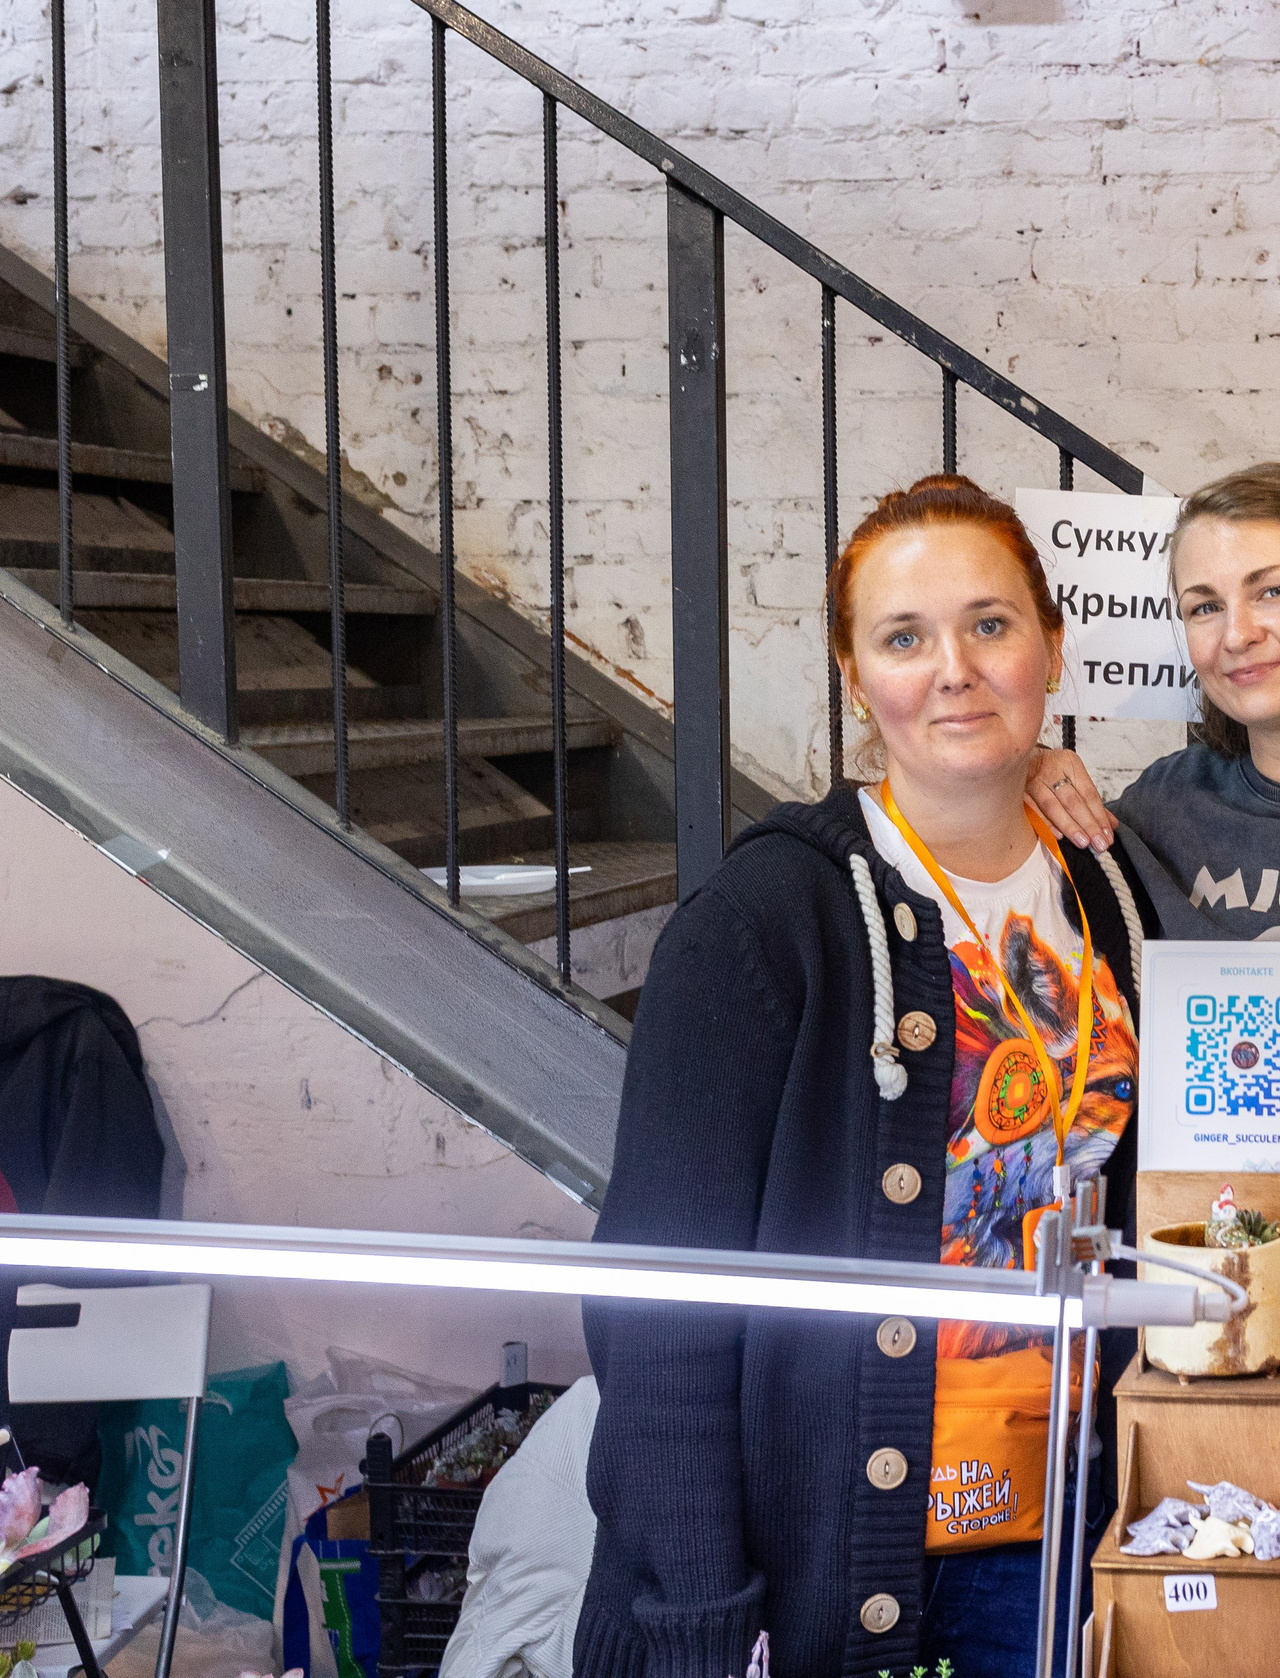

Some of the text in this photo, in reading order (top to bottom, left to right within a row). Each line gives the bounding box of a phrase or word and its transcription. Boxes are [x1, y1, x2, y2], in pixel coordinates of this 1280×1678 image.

[1056, 583, 1184, 625] Крым
[1220, 966, 1274, 977] ВКОНТАКТЕ
[930, 1460, 994, 1486] ДЬ НА
[1168, 1580, 1208, 1602] 400
